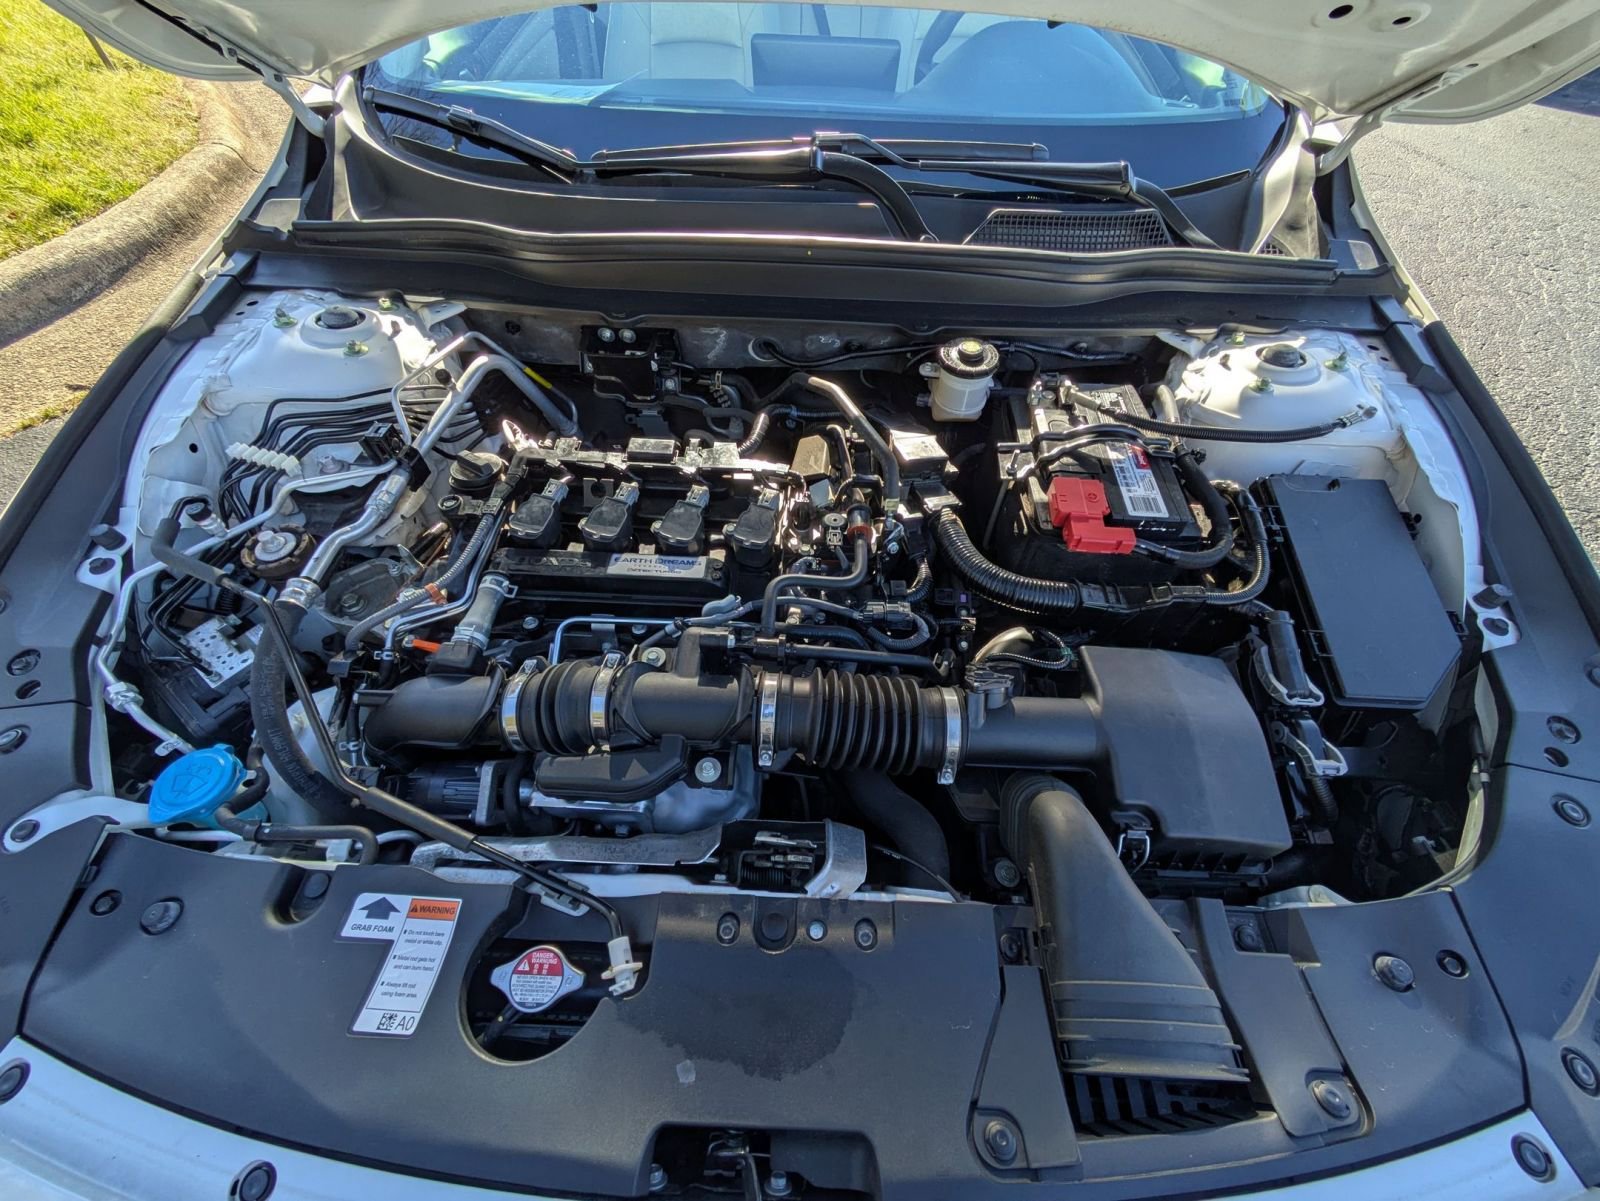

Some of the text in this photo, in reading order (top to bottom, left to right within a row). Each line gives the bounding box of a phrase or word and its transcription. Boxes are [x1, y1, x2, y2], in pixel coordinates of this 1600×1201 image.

[614, 556, 653, 565] EARTH
[655, 557, 702, 567] DREAMS
[419, 905, 456, 915] WARNING
[351, 923, 395, 933] GRAB FOAM
